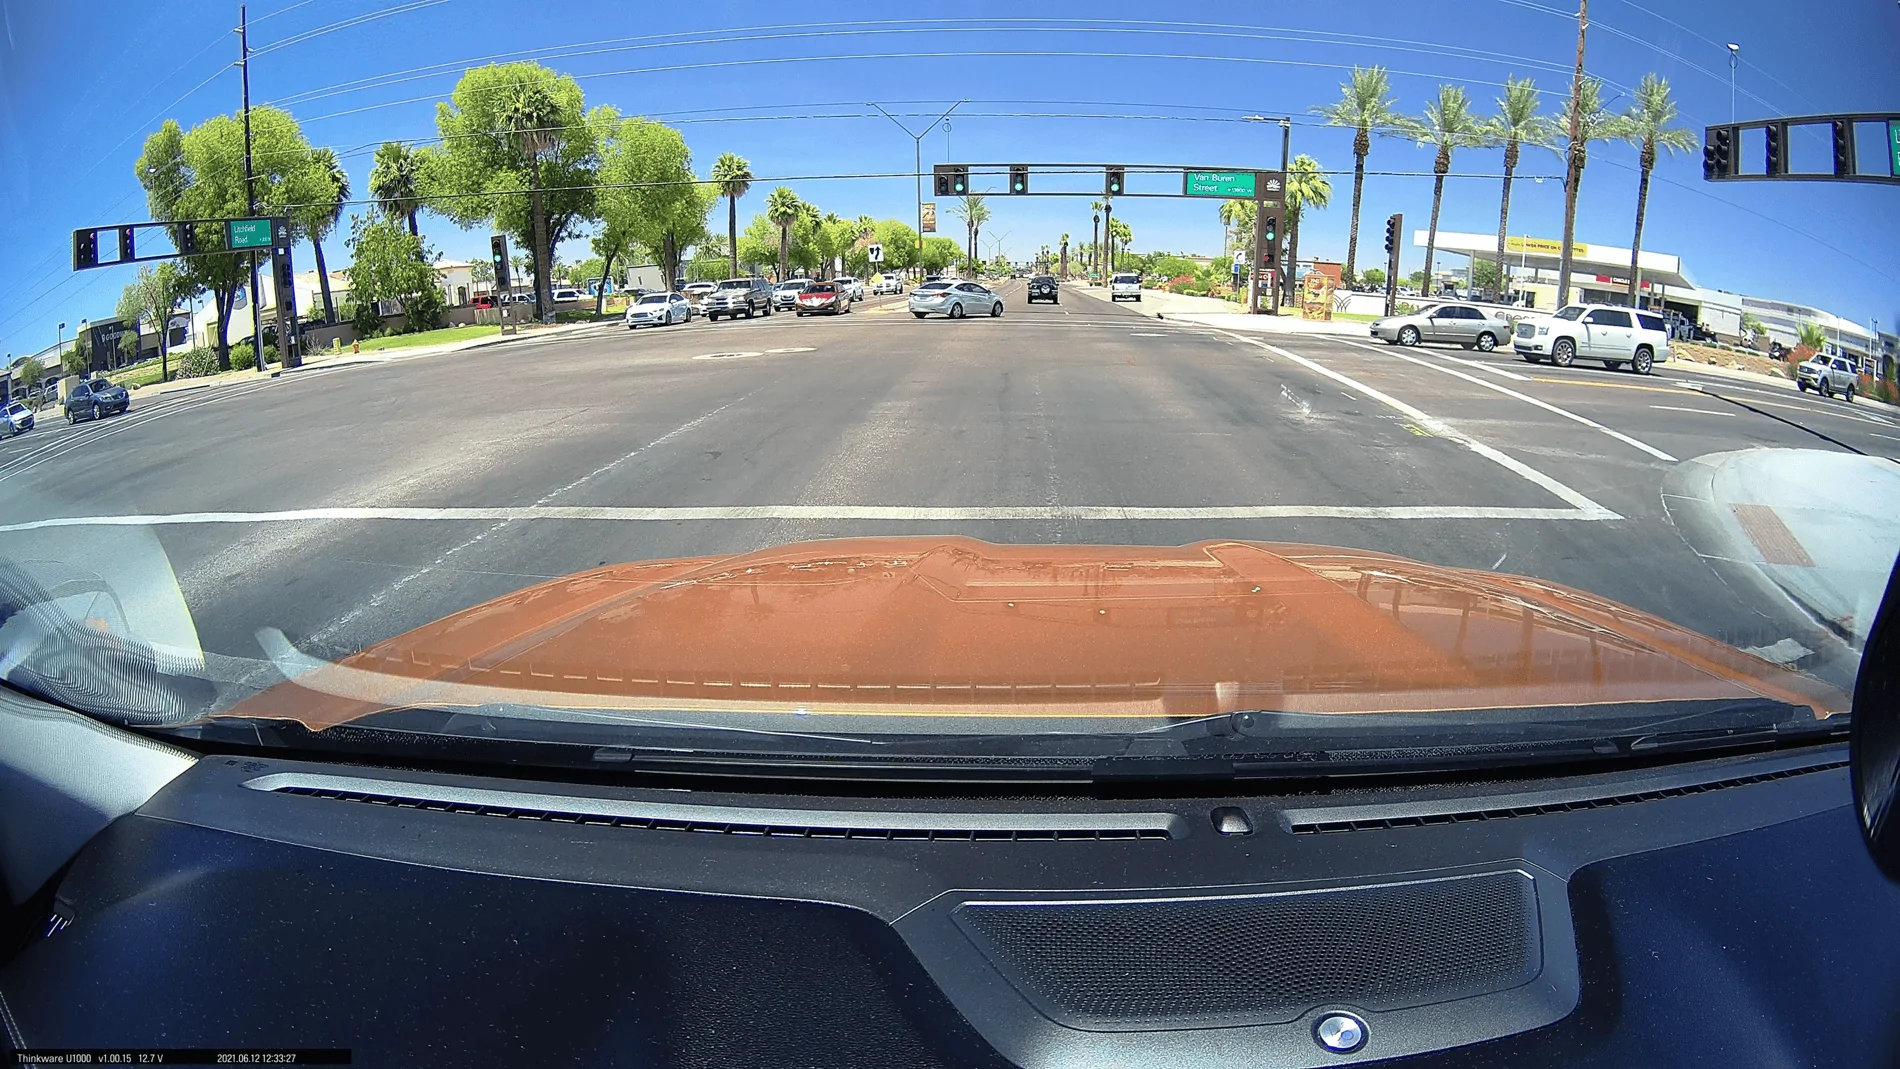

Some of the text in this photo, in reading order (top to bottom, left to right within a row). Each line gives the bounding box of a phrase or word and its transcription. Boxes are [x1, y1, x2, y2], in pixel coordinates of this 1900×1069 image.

[1194, 173, 1235, 182] Van Buren
[1193, 183, 1218, 192] Street
[234, 225, 255, 233] Litchfield
[234, 235, 249, 244] Road
